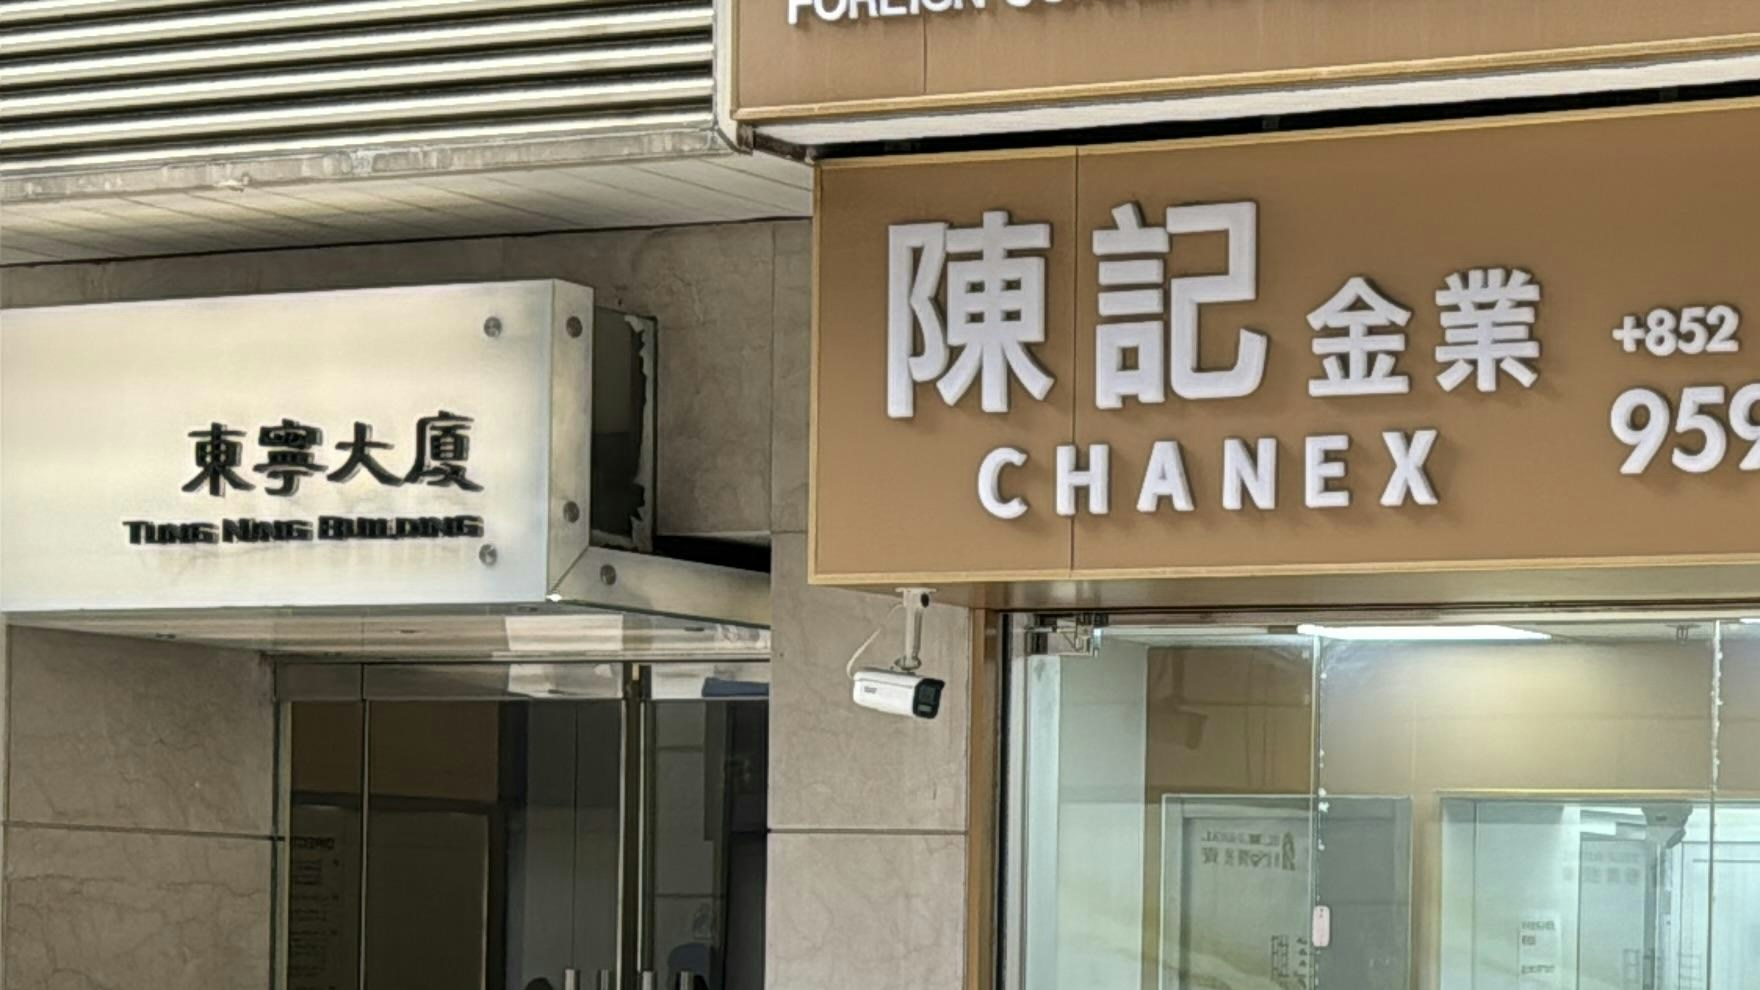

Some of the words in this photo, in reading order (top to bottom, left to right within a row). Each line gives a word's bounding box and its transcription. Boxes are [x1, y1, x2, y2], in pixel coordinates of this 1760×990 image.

[886, 200, 1542, 419] 陳記金業
[1612, 304, 1740, 358] +852
[181, 410, 485, 498] 東寧大廈
[978, 429, 1439, 520] CHANEX
